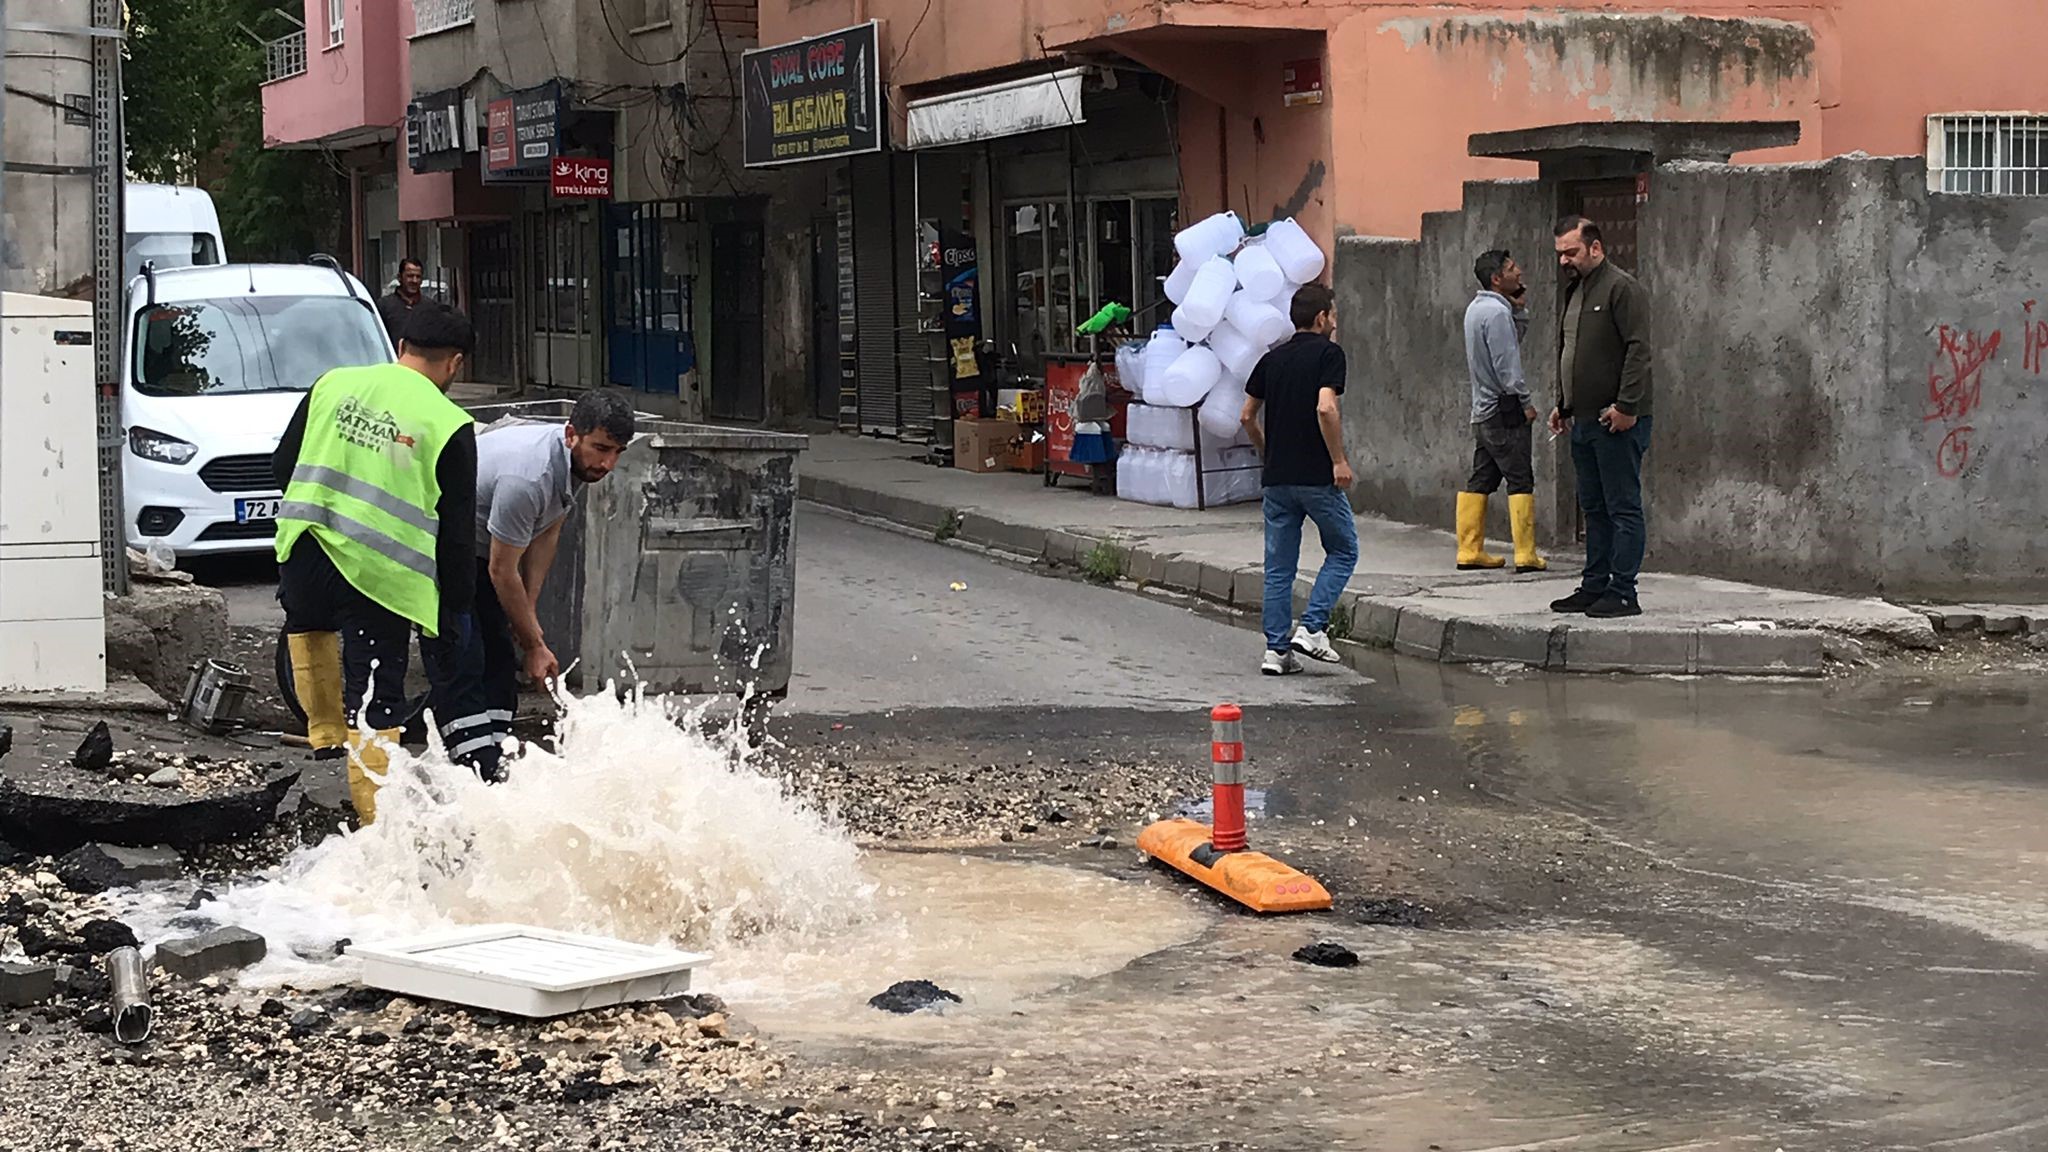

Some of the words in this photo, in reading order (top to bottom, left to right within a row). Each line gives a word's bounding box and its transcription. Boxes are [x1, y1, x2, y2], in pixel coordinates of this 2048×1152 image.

[770, 51, 804, 89] DUAL
[807, 38, 846, 82] CORE
[575, 163, 608, 184] king
[336, 409, 400, 442] BATMAN
[246, 502, 267, 518] 72
